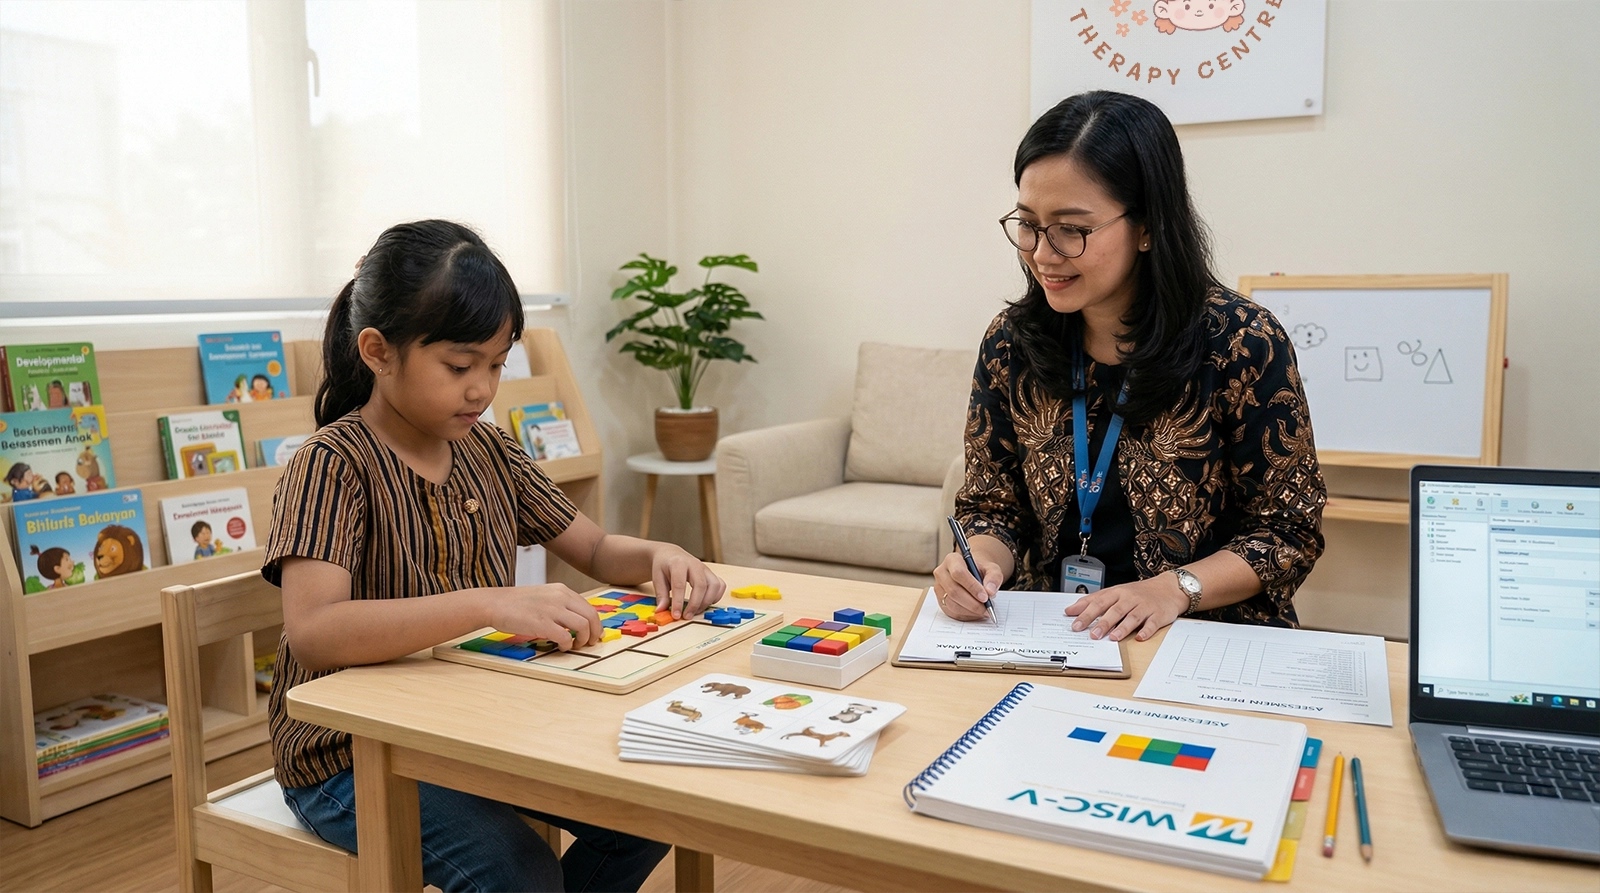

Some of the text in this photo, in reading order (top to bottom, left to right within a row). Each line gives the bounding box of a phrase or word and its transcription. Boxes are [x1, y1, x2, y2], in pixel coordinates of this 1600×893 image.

[1070, 8, 1180, 85] THERAPY
[78, 509, 137, 526] Bakaryan
[1006, 789, 1177, 831] WISC-V
